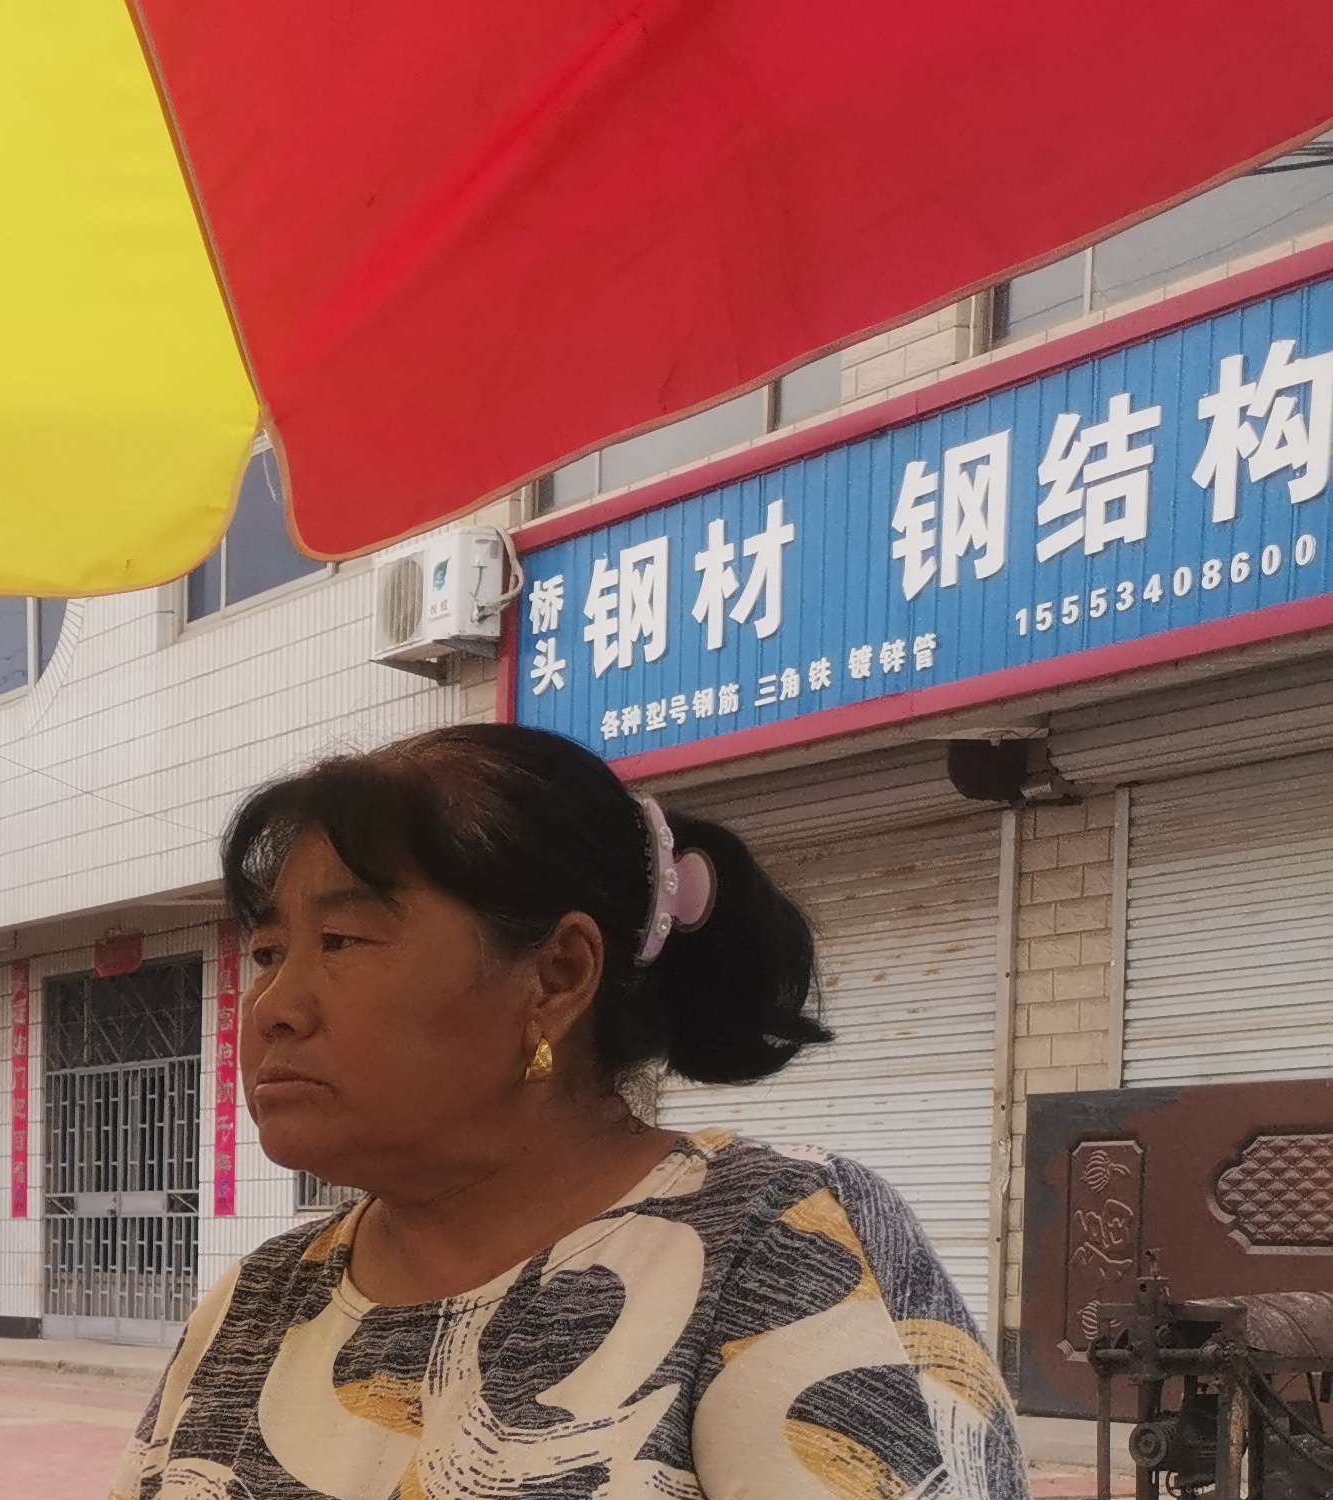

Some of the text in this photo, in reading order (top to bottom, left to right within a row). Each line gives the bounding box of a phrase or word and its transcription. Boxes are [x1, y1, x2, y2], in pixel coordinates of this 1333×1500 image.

[583, 339, 1333, 678] 钢材 钢结构
[529, 574, 566, 696] 桥头
[1016, 531, 1316, 637] 15553408600
[601, 632, 938, 741] 各种型号钢筋 三角铁 镀锌管
